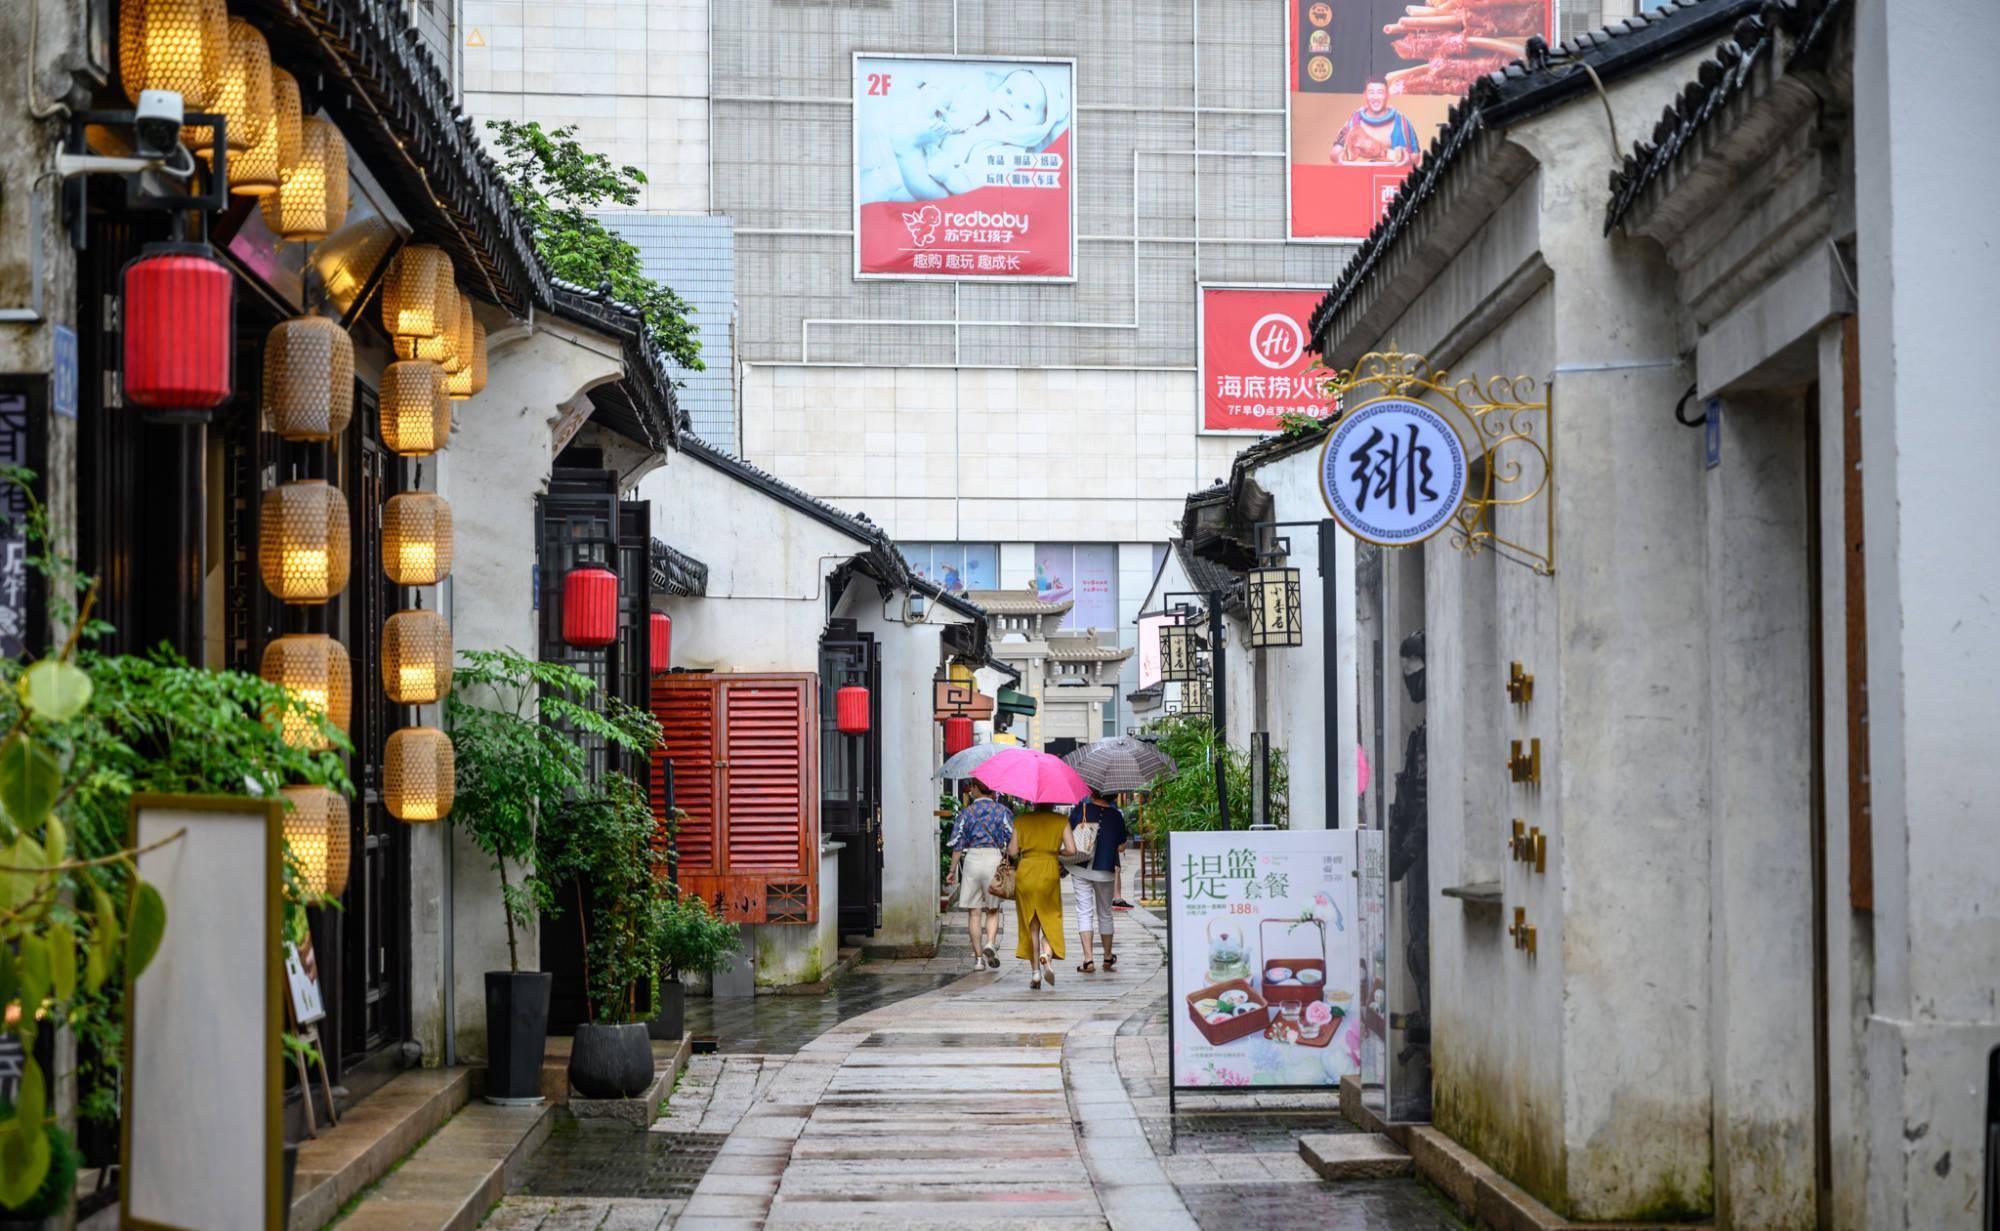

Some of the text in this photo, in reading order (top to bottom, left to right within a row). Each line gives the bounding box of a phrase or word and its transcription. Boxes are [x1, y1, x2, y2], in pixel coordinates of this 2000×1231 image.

[868, 73, 892, 97] 2F
[944, 210, 1029, 234] redbaby
[943, 229, 1014, 244] 苏宁红孩子
[913, 253, 1021, 271] 趣购 趣玩 趣成长
[1261, 324, 1292, 357] Hi
